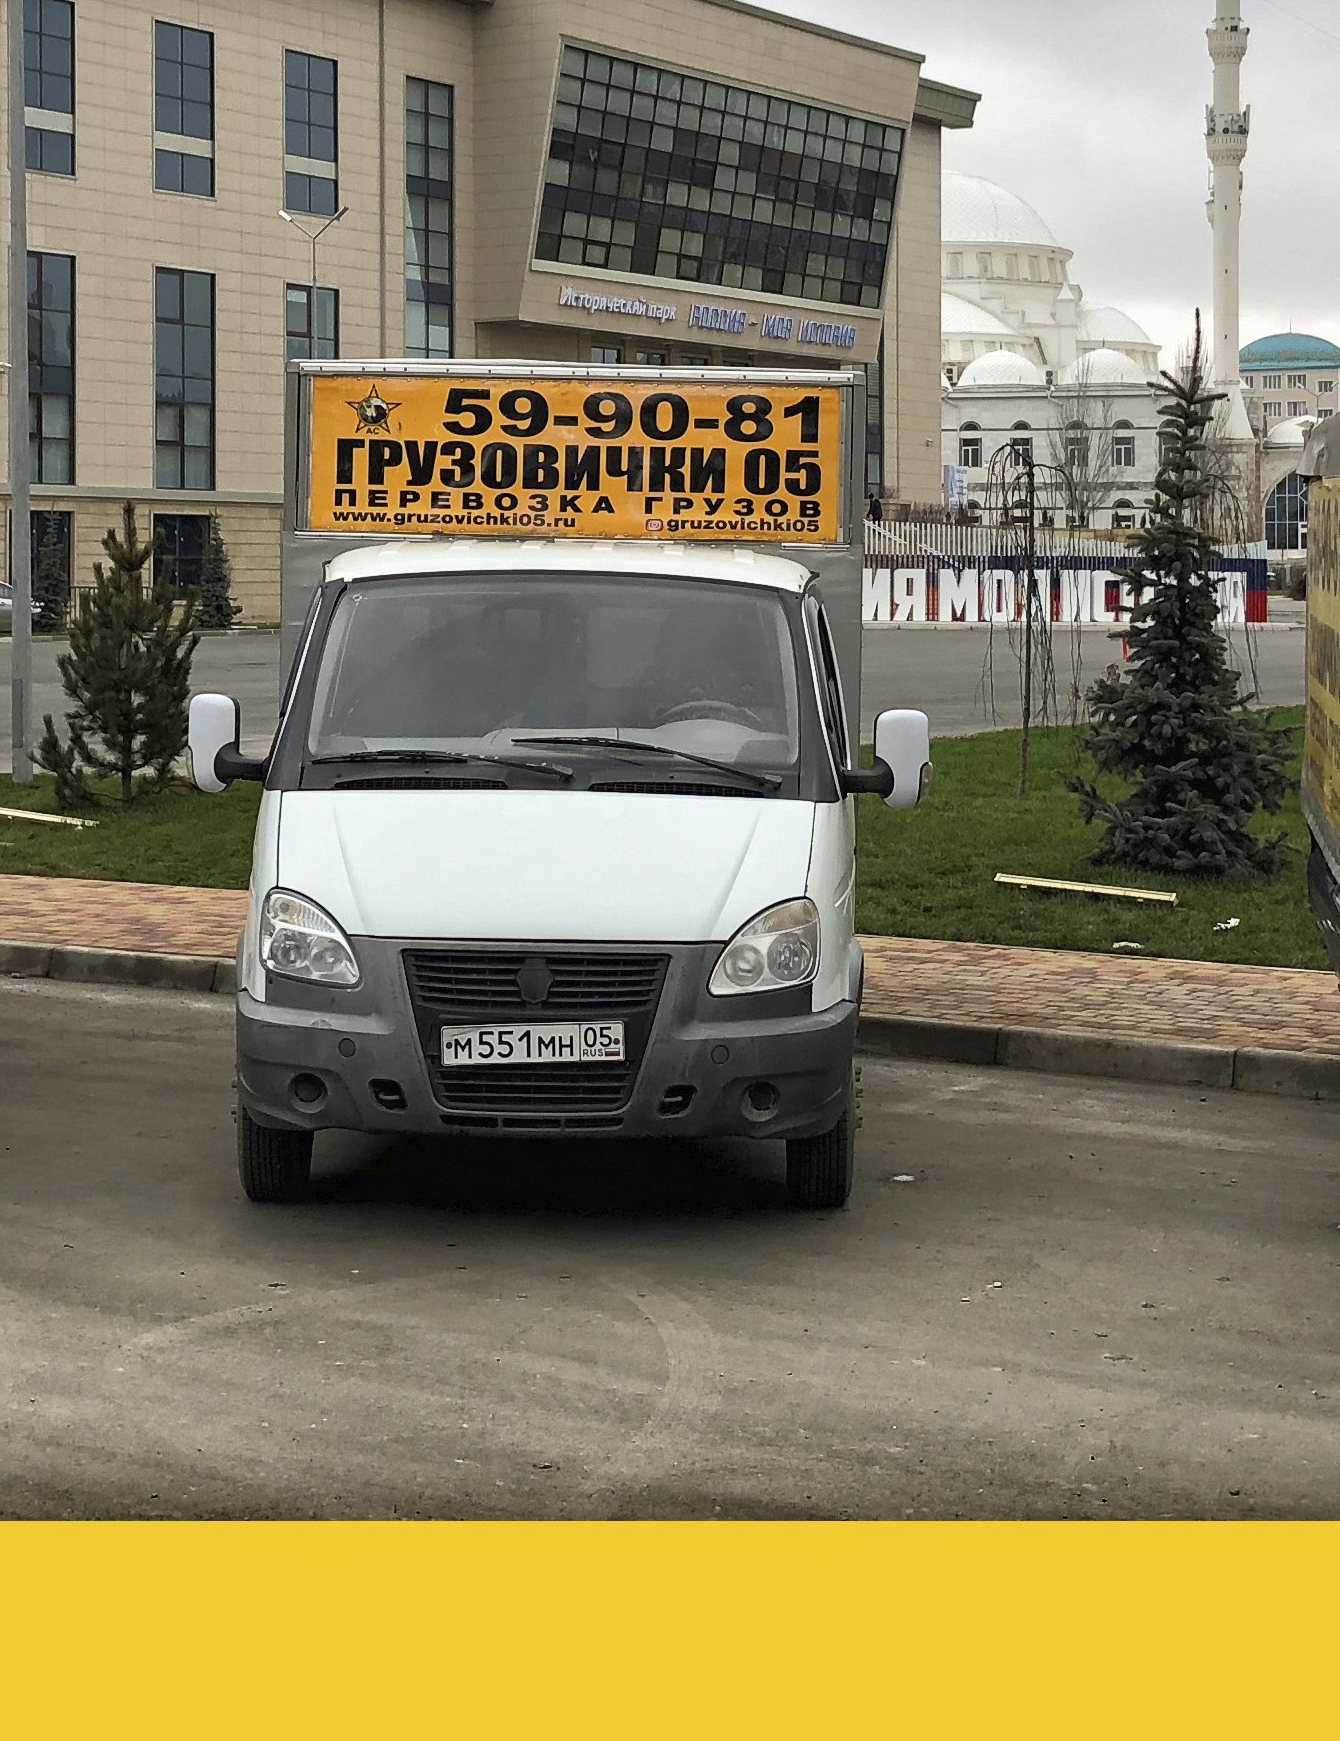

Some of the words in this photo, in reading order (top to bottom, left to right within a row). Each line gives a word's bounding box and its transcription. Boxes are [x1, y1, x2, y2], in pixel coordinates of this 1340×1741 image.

[559, 286, 646, 315] Исторический
[647, 303, 677, 323] парк
[688, 303, 747, 333] РОССИЯ
[762, 313, 793, 340] МОЯ
[798, 319, 857, 349] ИСТОРИЯ
[442, 388, 819, 443] 59-90-81
[336, 438, 726, 493] ГРУЗОВИЧКИ
[744, 448, 821, 496] 05
[335, 489, 615, 513] ПЕРЕВОЗКА
[645, 497, 821, 517] ГРУЗОВ
[333, 511, 575, 527] www.gruzovichki05.ru
[667, 518, 819, 532] gruzovichki05
[454, 1030, 574, 1059] М551МН
[583, 1026, 612, 1047] 05
[583, 1049, 604, 1057] RUS
